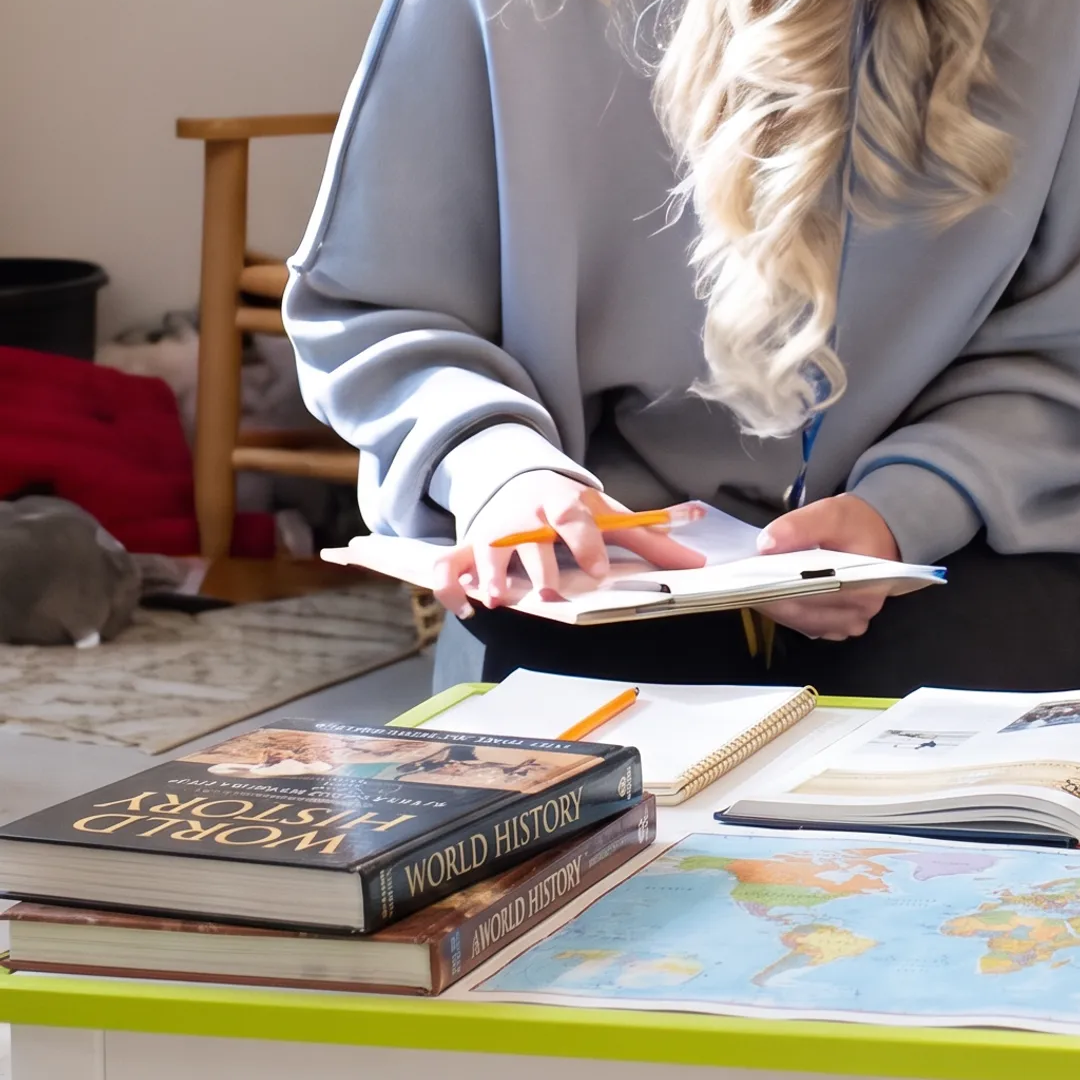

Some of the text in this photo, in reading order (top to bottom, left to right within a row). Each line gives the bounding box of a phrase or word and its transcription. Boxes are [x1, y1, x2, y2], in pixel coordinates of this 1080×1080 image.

[72, 812, 347, 855] WORLD
[93, 791, 417, 833] HISTORY
[404, 833, 488, 897] WORLD
[494, 786, 584, 859] HISTORY
[528, 854, 582, 918] HISTORY
